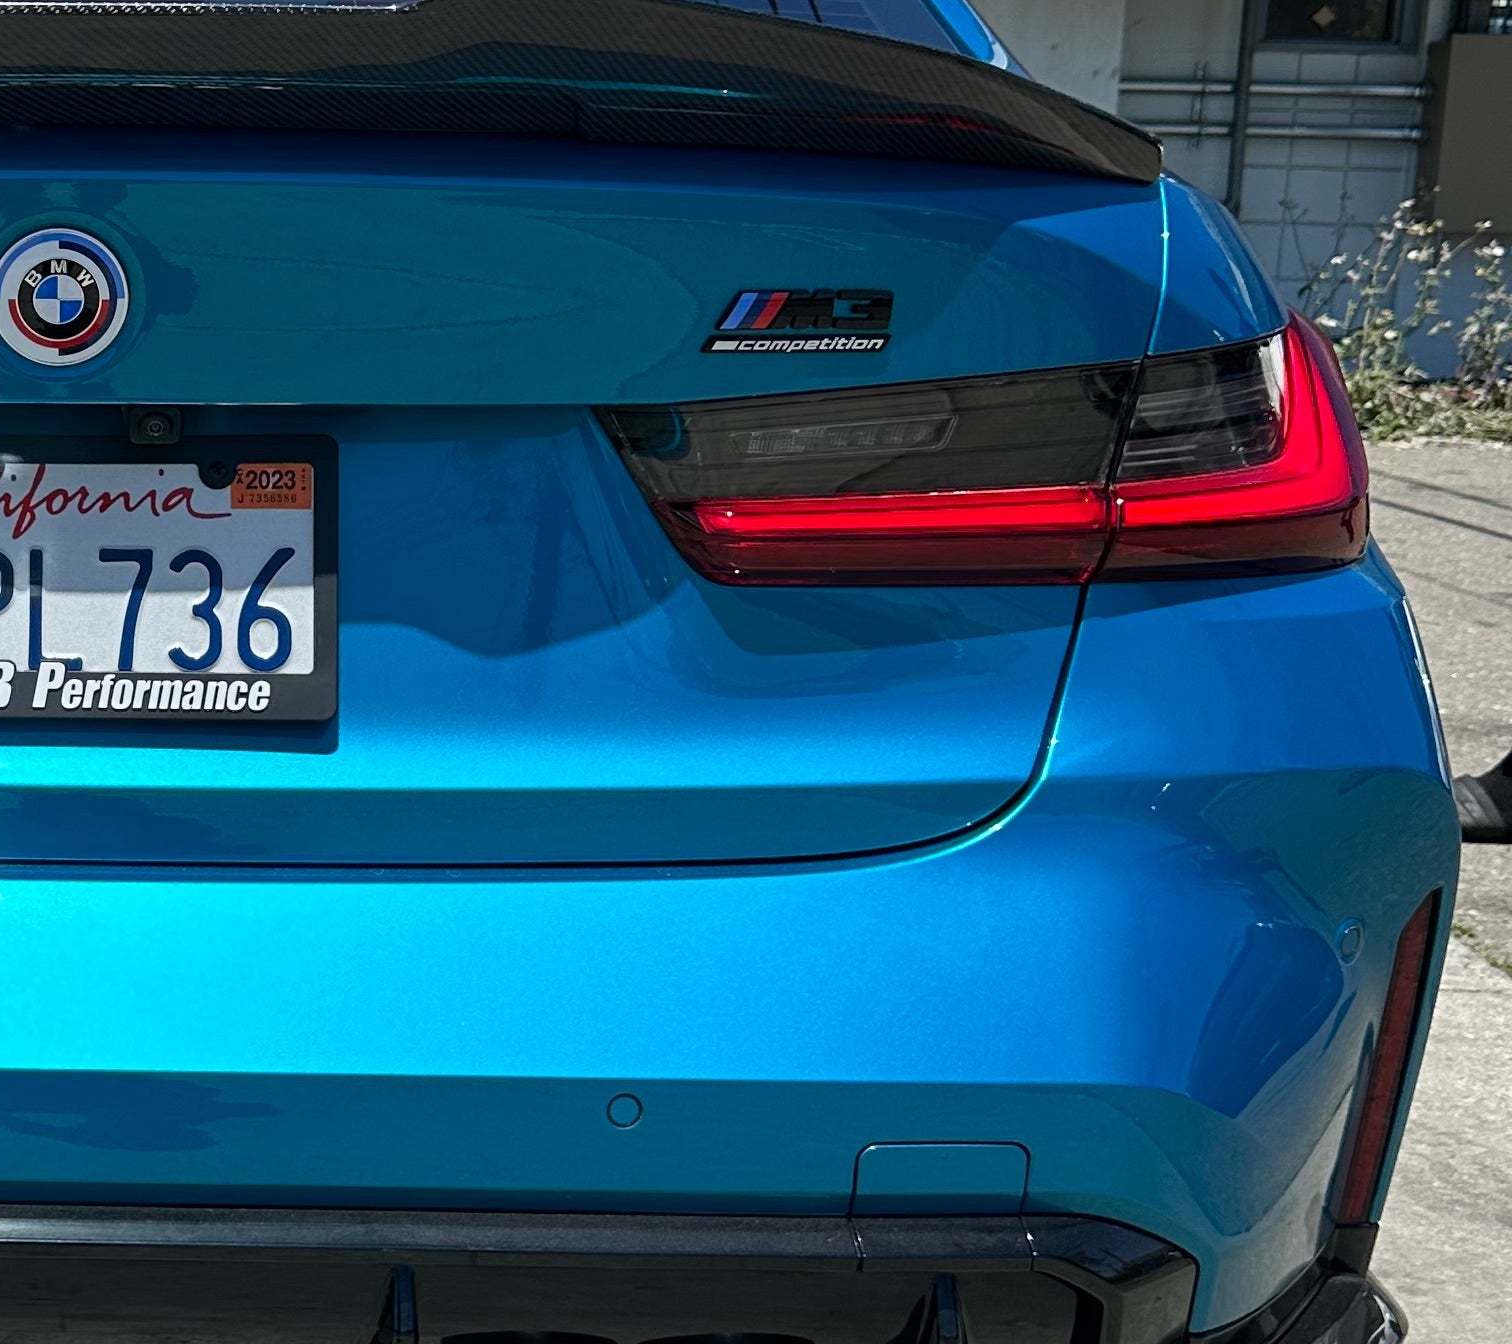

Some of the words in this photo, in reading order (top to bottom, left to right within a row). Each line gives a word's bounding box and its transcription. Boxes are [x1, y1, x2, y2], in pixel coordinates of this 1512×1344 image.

[24, 259, 95, 288] BMW
[738, 337, 884, 353] competition
[245, 470, 297, 490] 2023
[33, 660, 272, 712] Performance
